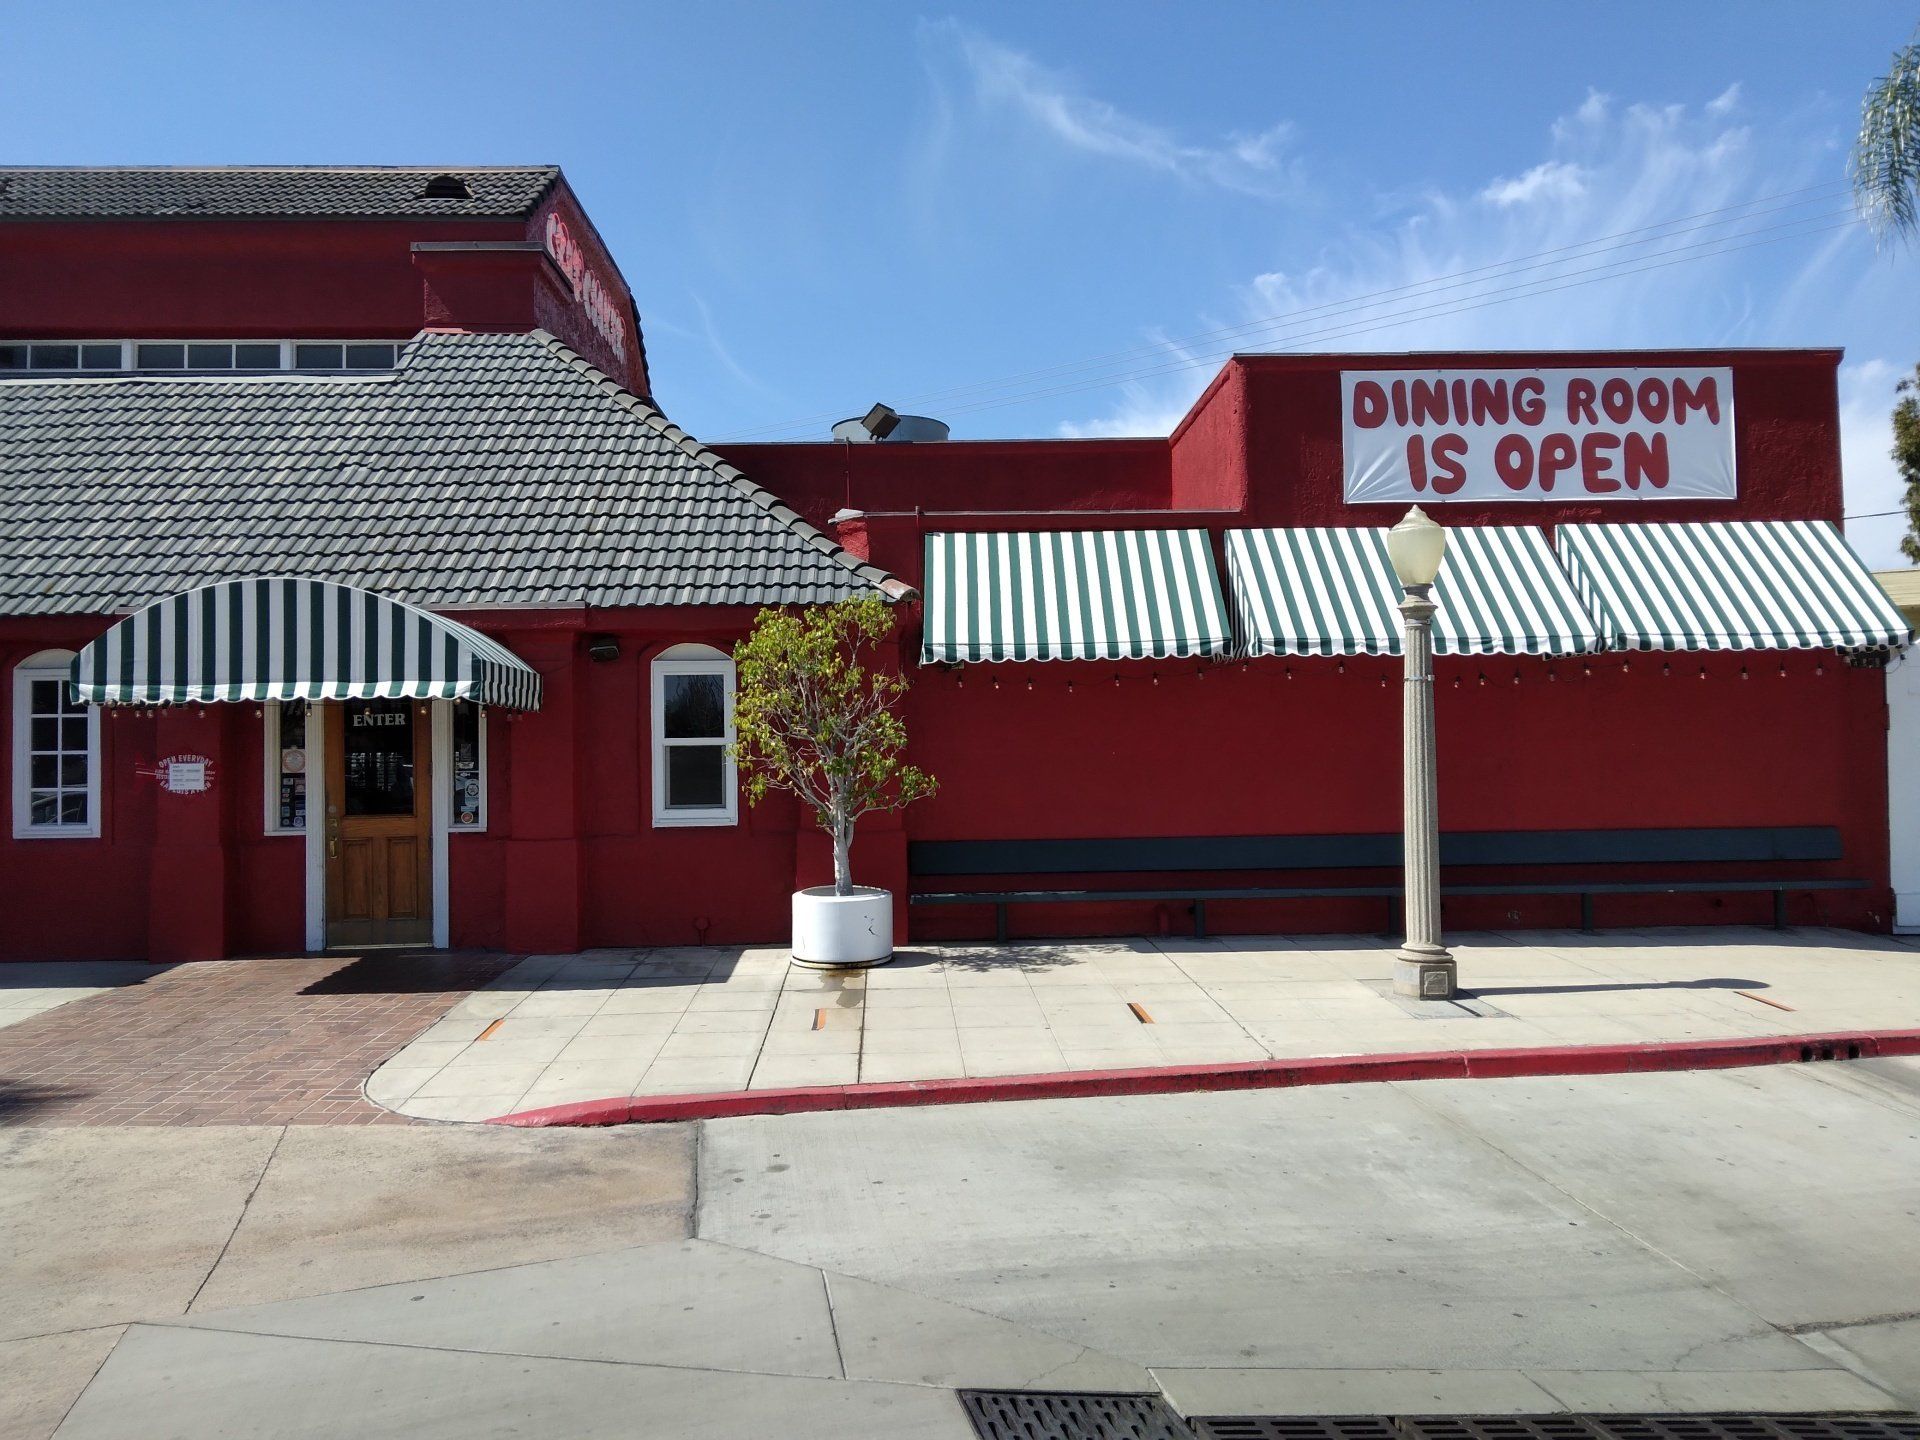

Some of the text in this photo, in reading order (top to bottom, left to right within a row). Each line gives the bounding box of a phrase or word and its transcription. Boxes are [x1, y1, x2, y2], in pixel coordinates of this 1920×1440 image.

[1352, 376, 1721, 429] DINING ROOM
[1406, 431, 1670, 494] IS OPEN
[353, 713, 406, 726] ENTER
[158, 754, 213, 768] OPEN EVERYDAY
